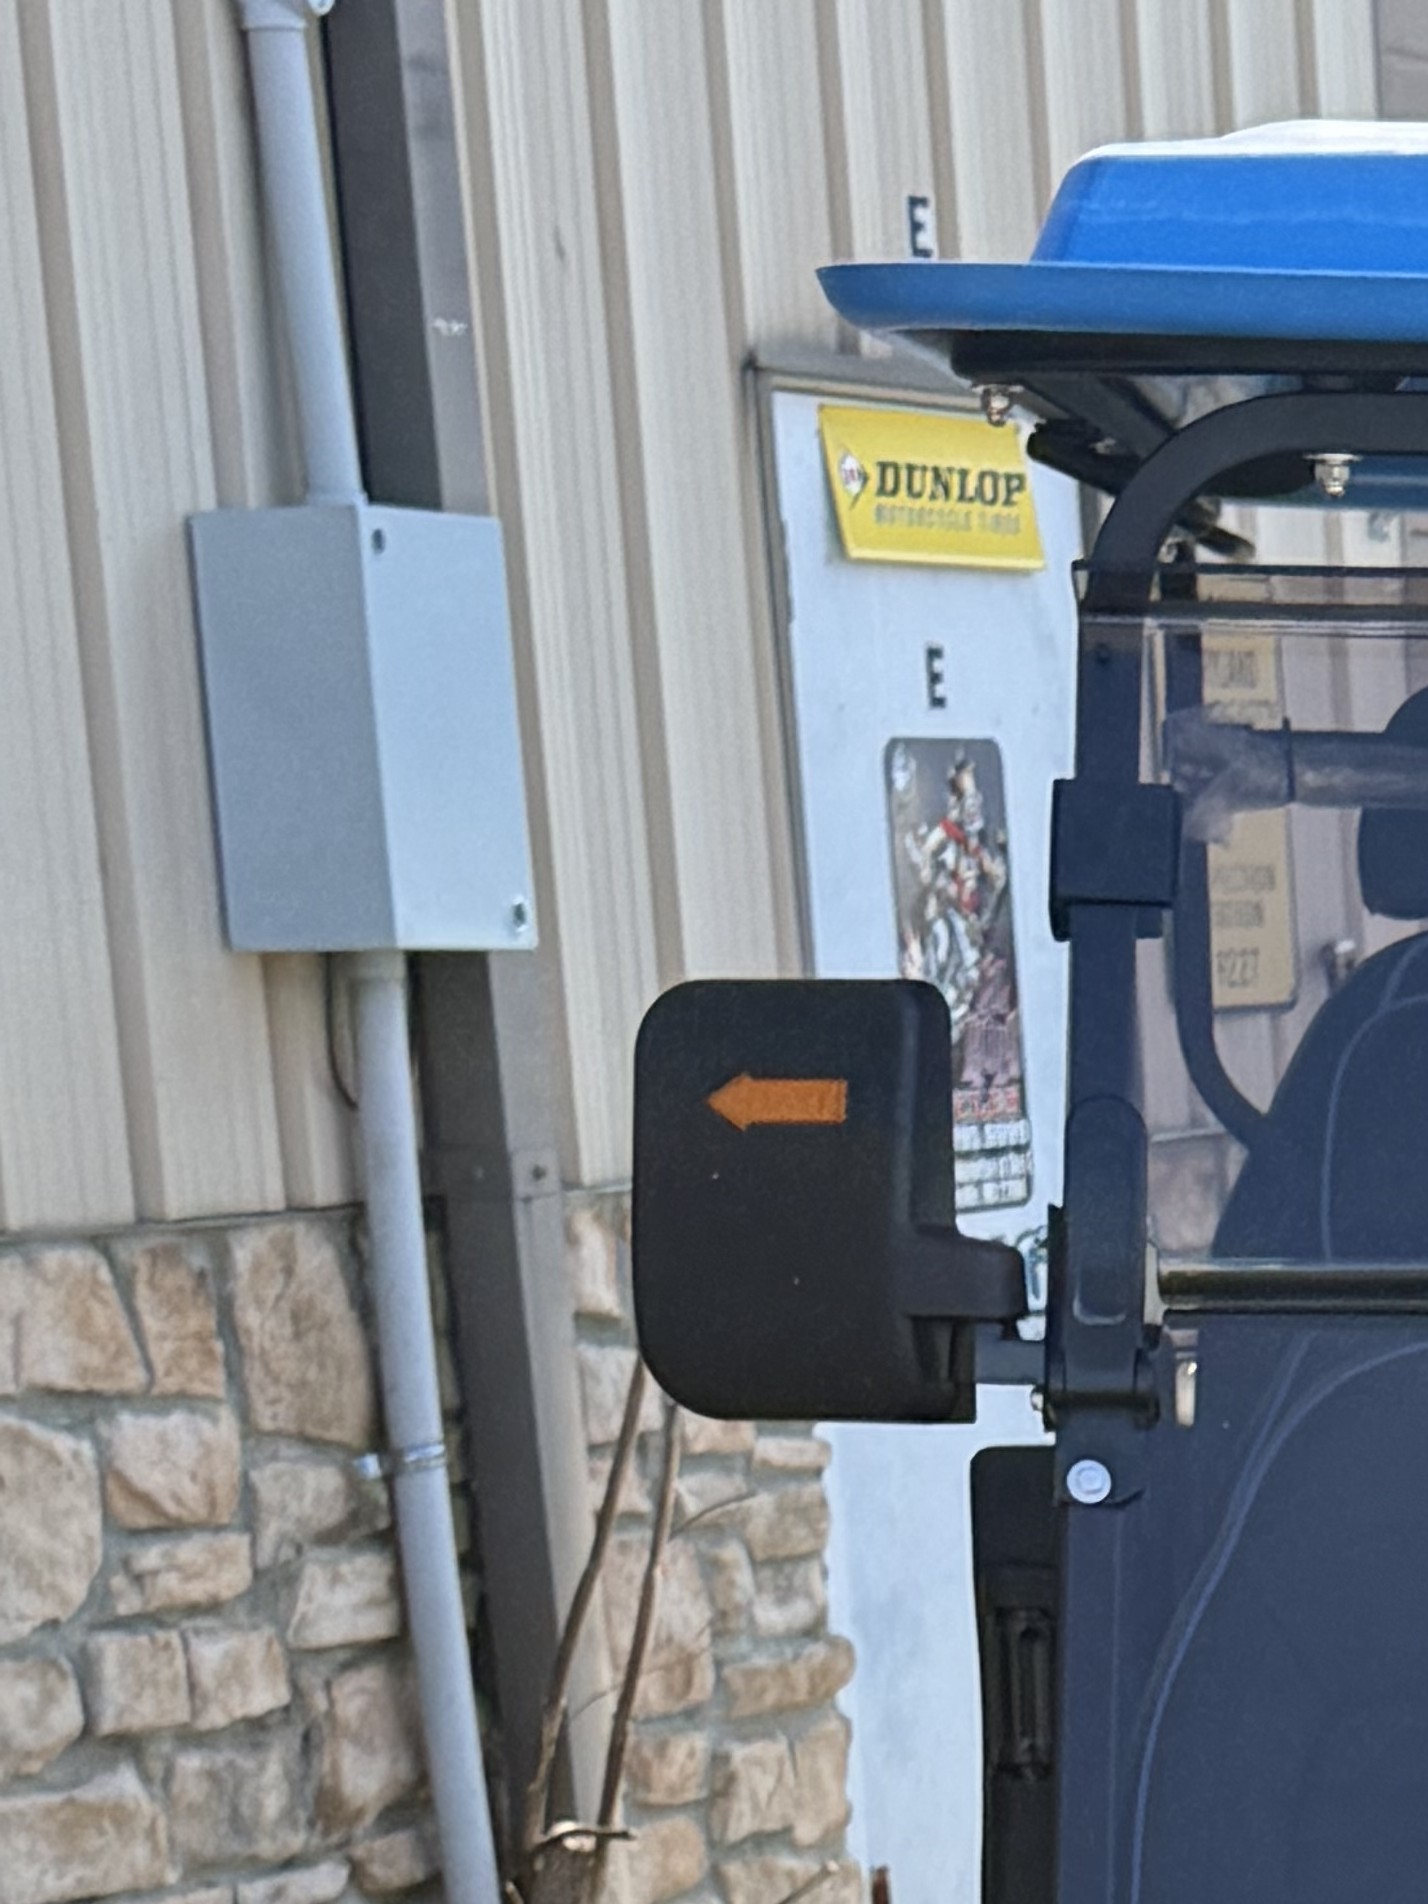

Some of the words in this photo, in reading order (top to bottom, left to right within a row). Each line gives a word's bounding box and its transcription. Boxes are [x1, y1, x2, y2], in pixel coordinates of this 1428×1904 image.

[907, 194, 935, 259] E
[875, 460, 1027, 507] DUNLOP
[925, 646, 948, 710] E
